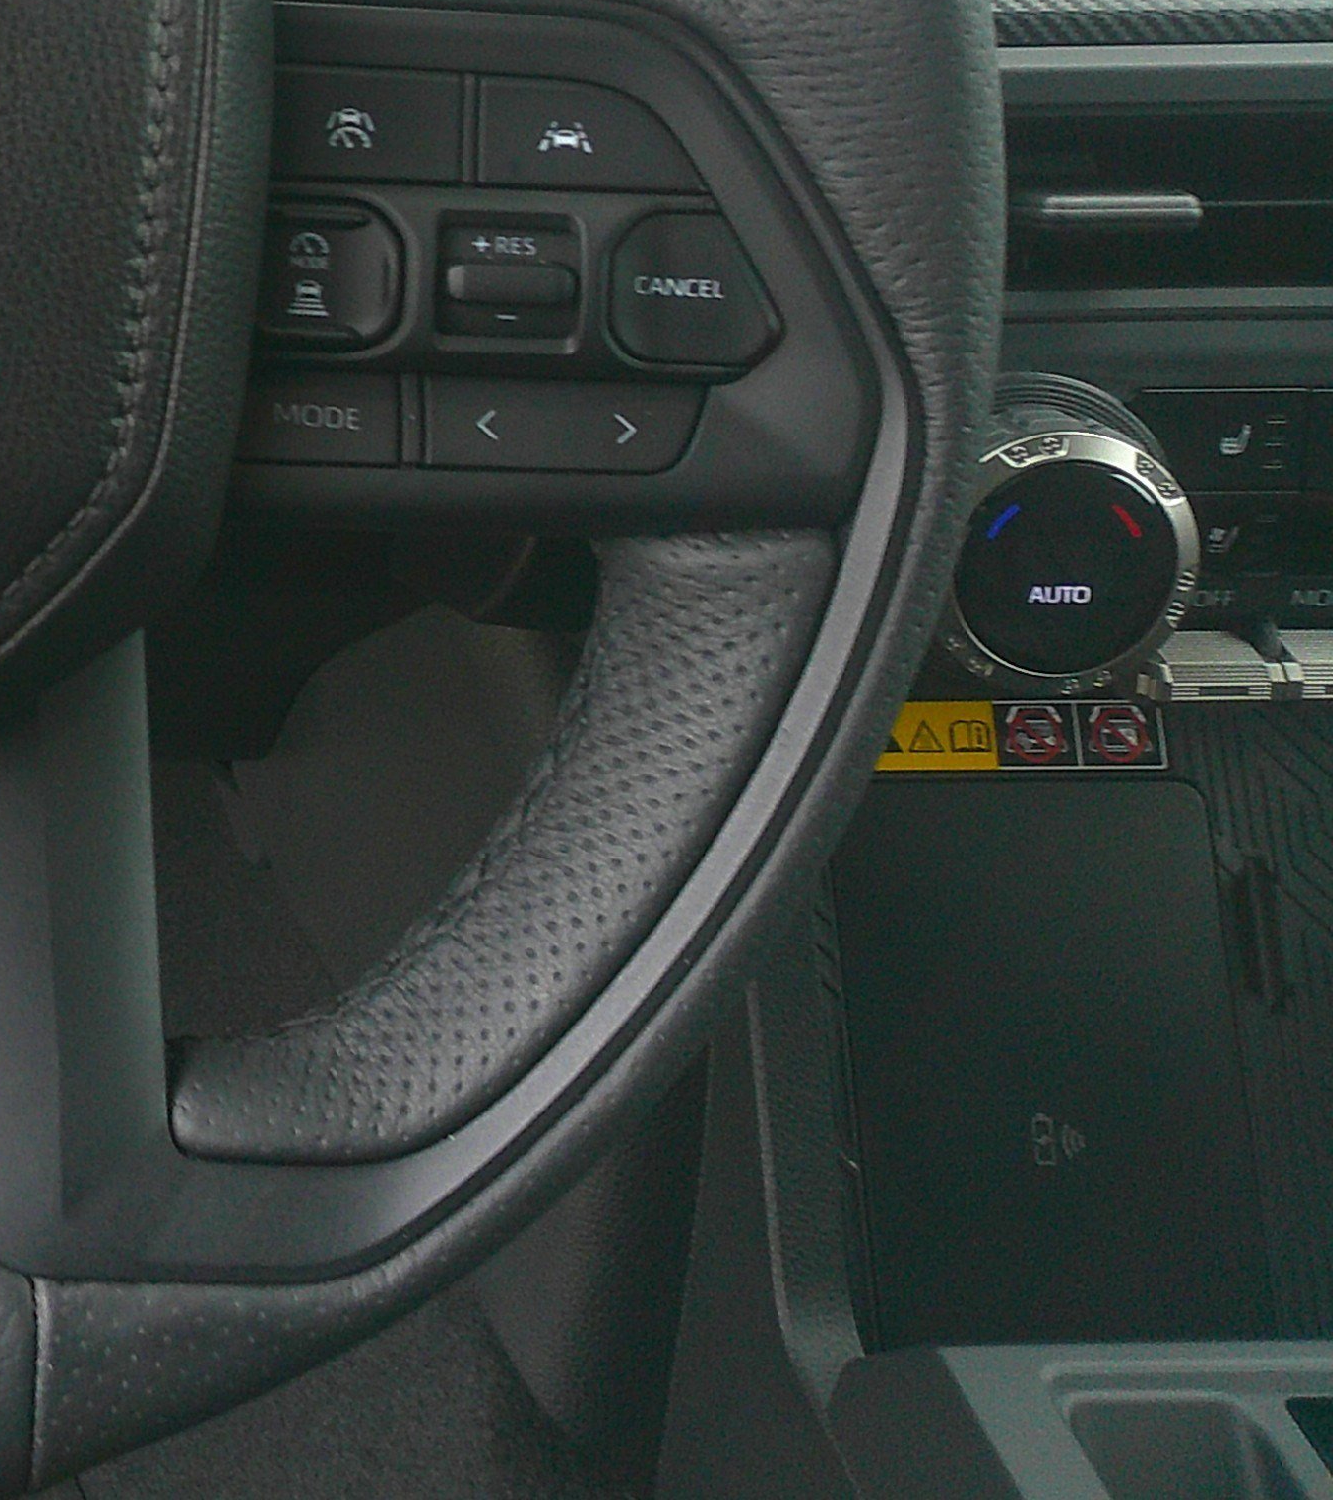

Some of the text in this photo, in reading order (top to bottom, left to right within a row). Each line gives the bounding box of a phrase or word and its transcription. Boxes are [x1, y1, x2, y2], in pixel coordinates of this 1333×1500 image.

[633, 275, 725, 300] CANCEL
[272, 402, 361, 431] MODE
[1027, 585, 1093, 605] AUTO
